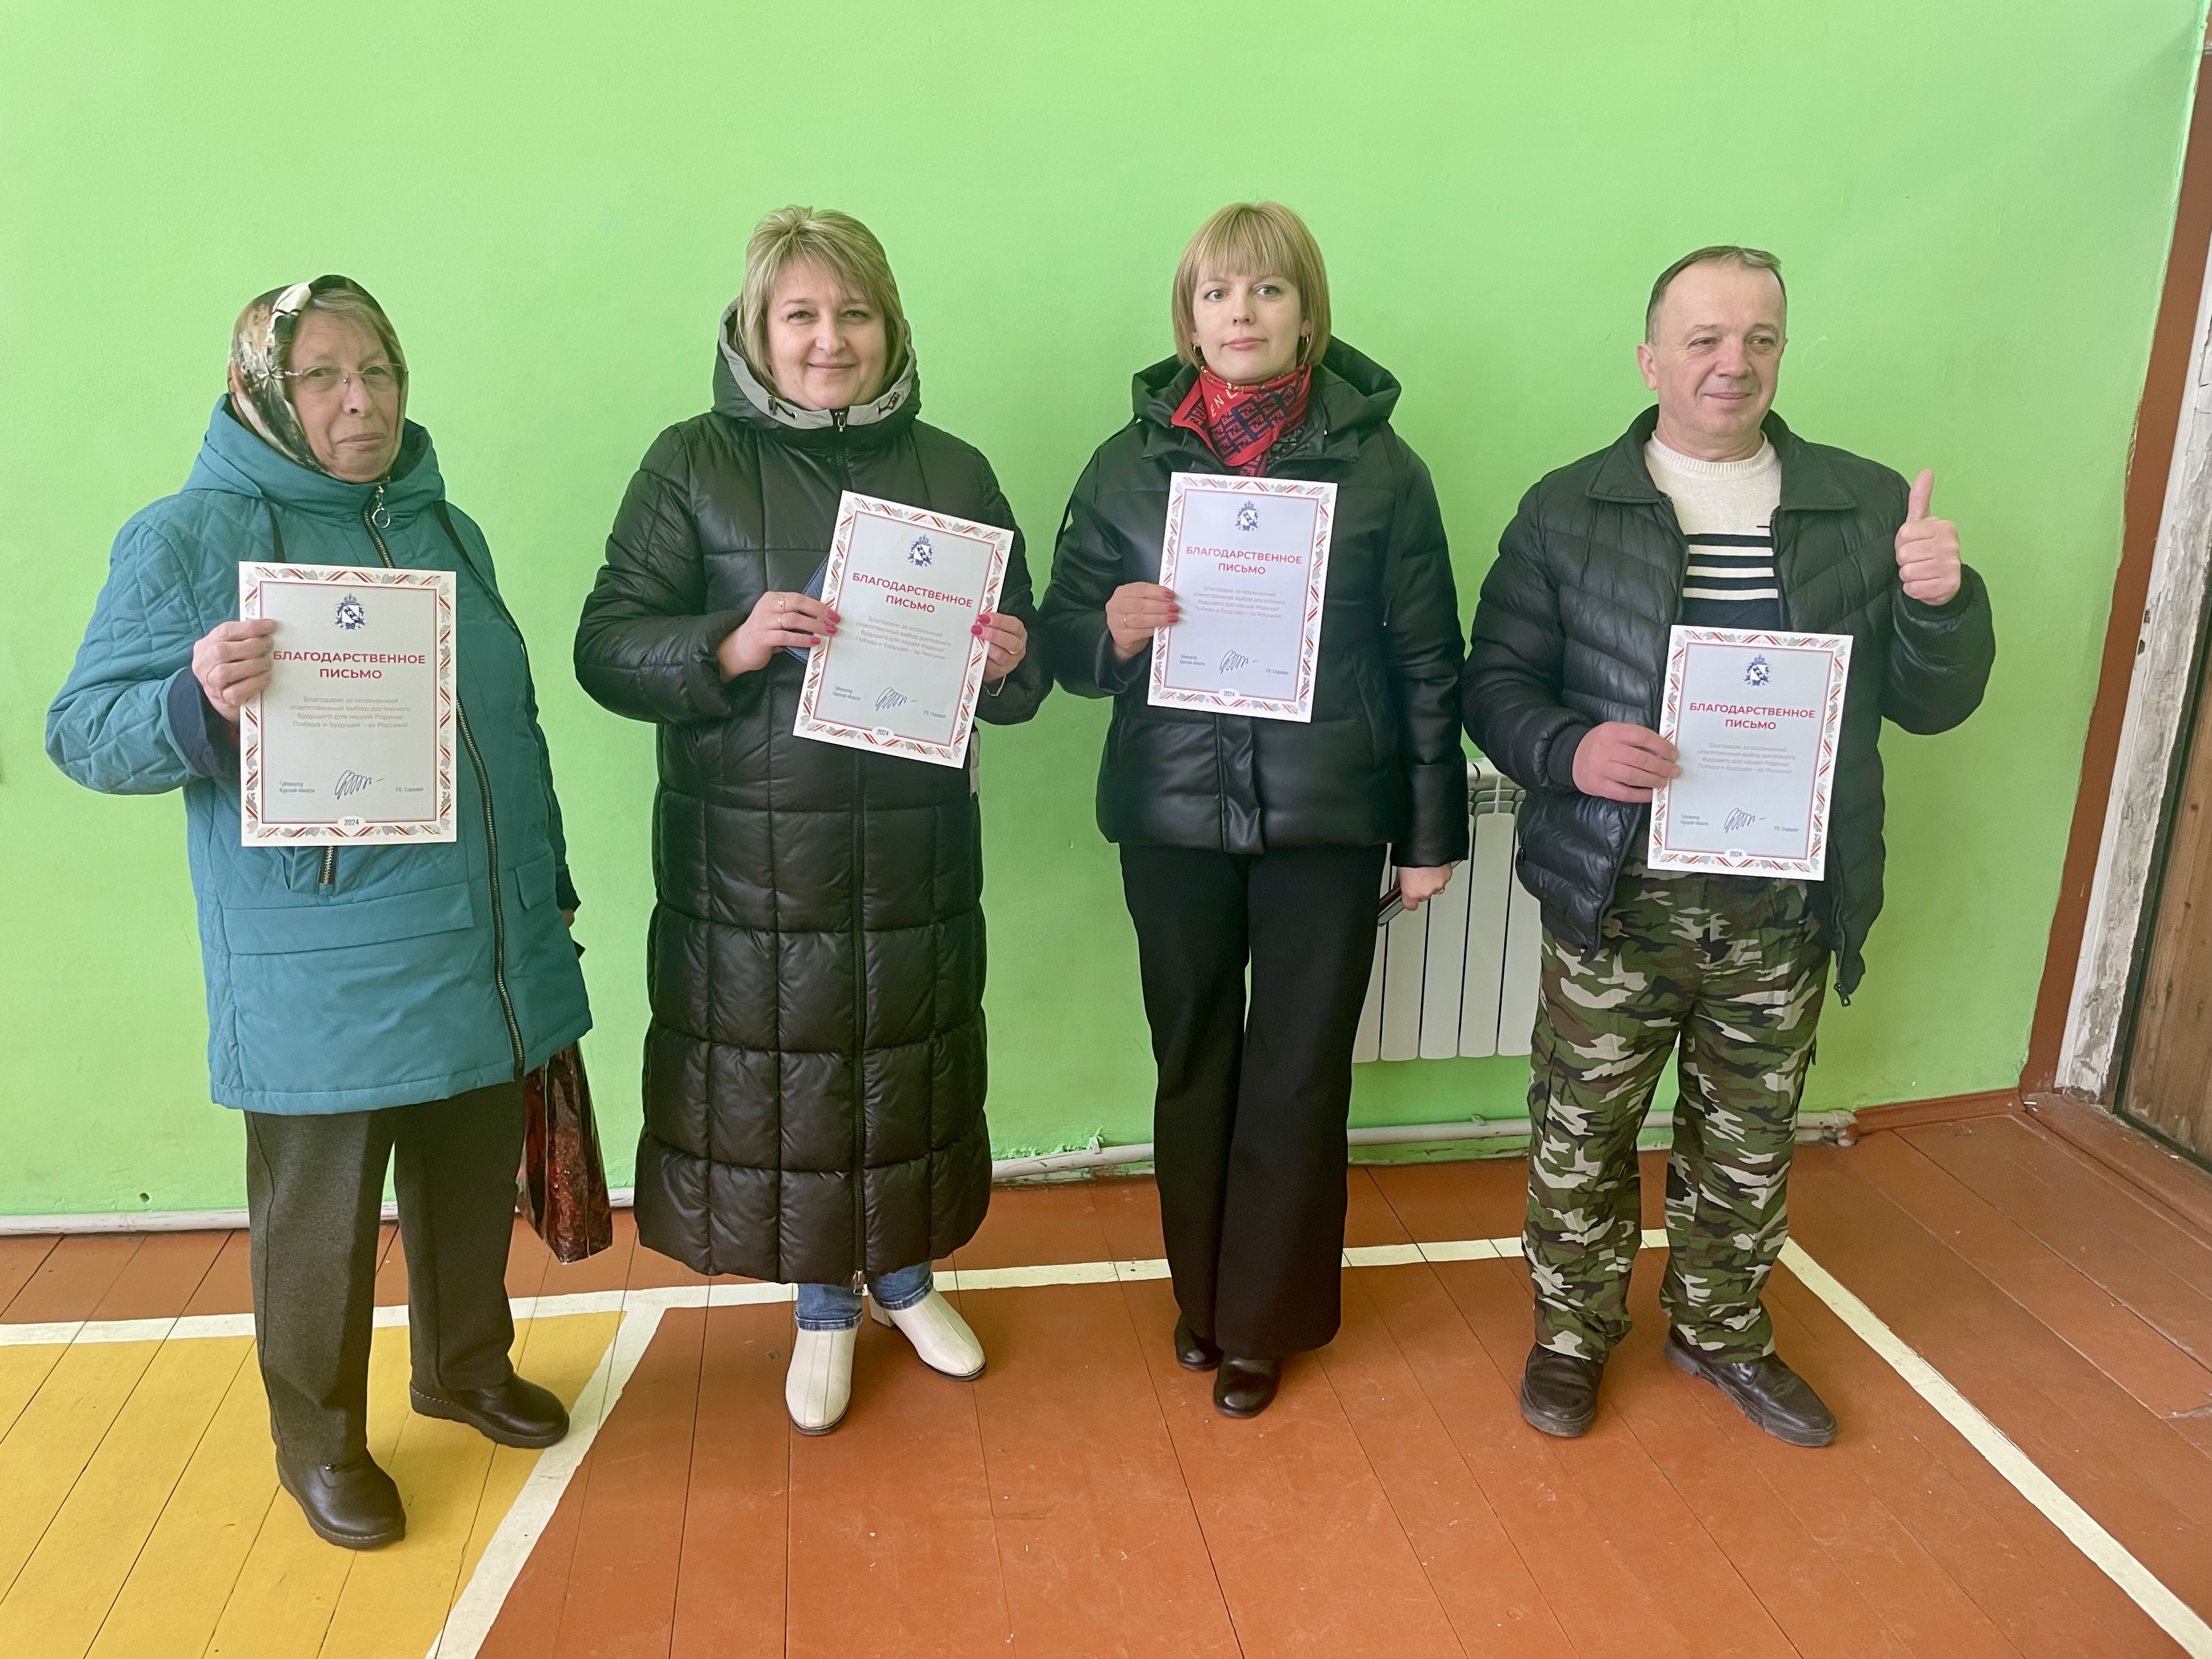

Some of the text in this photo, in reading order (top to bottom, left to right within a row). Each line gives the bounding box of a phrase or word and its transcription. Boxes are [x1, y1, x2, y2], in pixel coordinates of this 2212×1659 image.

[1186, 546, 1302, 565] БЛАГОДАРСТВЕННОЕ
[1218, 563, 1266, 574] ПИСЬМО
[851, 572, 973, 608] БЛАГОДАРСТВЕННОЕ
[885, 595, 935, 613] ПИСЬМО
[273, 651, 425, 665] БЛАГОДАРСТВЕННОЕ
[320, 668, 382, 679] ПИСЬМО
[1689, 702, 1815, 720] БЛАГОДАРСТВЕННОЕ
[1725, 719, 1776, 730] ПИСЬМО
